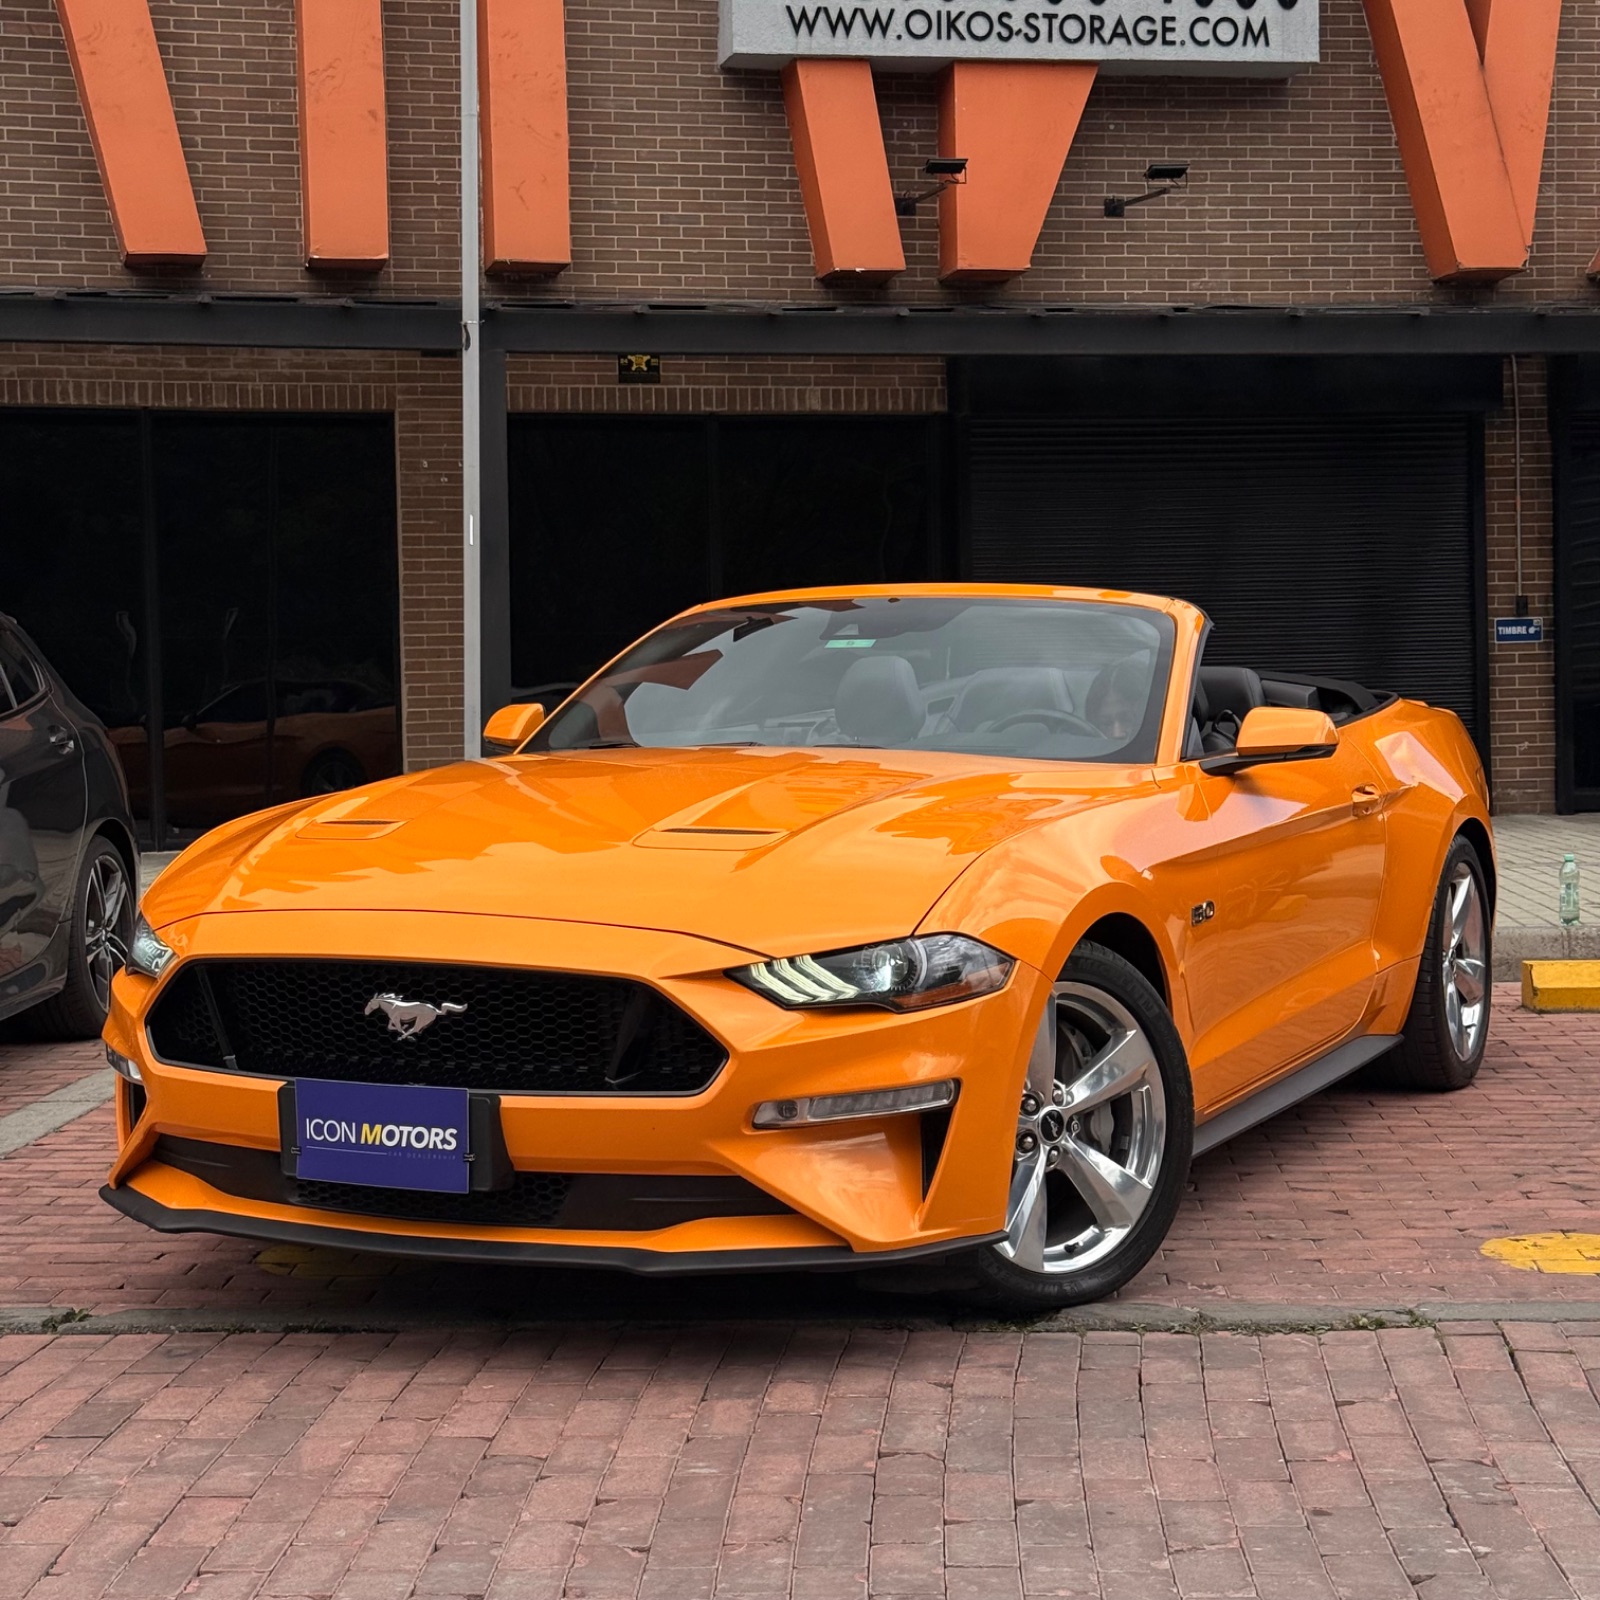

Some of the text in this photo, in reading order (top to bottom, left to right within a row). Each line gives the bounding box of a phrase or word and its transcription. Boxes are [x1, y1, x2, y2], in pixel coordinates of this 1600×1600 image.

[785, 5, 1270, 48] WWW.OIKOS-STORAGE.COM
[1497, 626, 1527, 635] TIMBRE
[305, 1117, 458, 1150] ICON MOTORS
